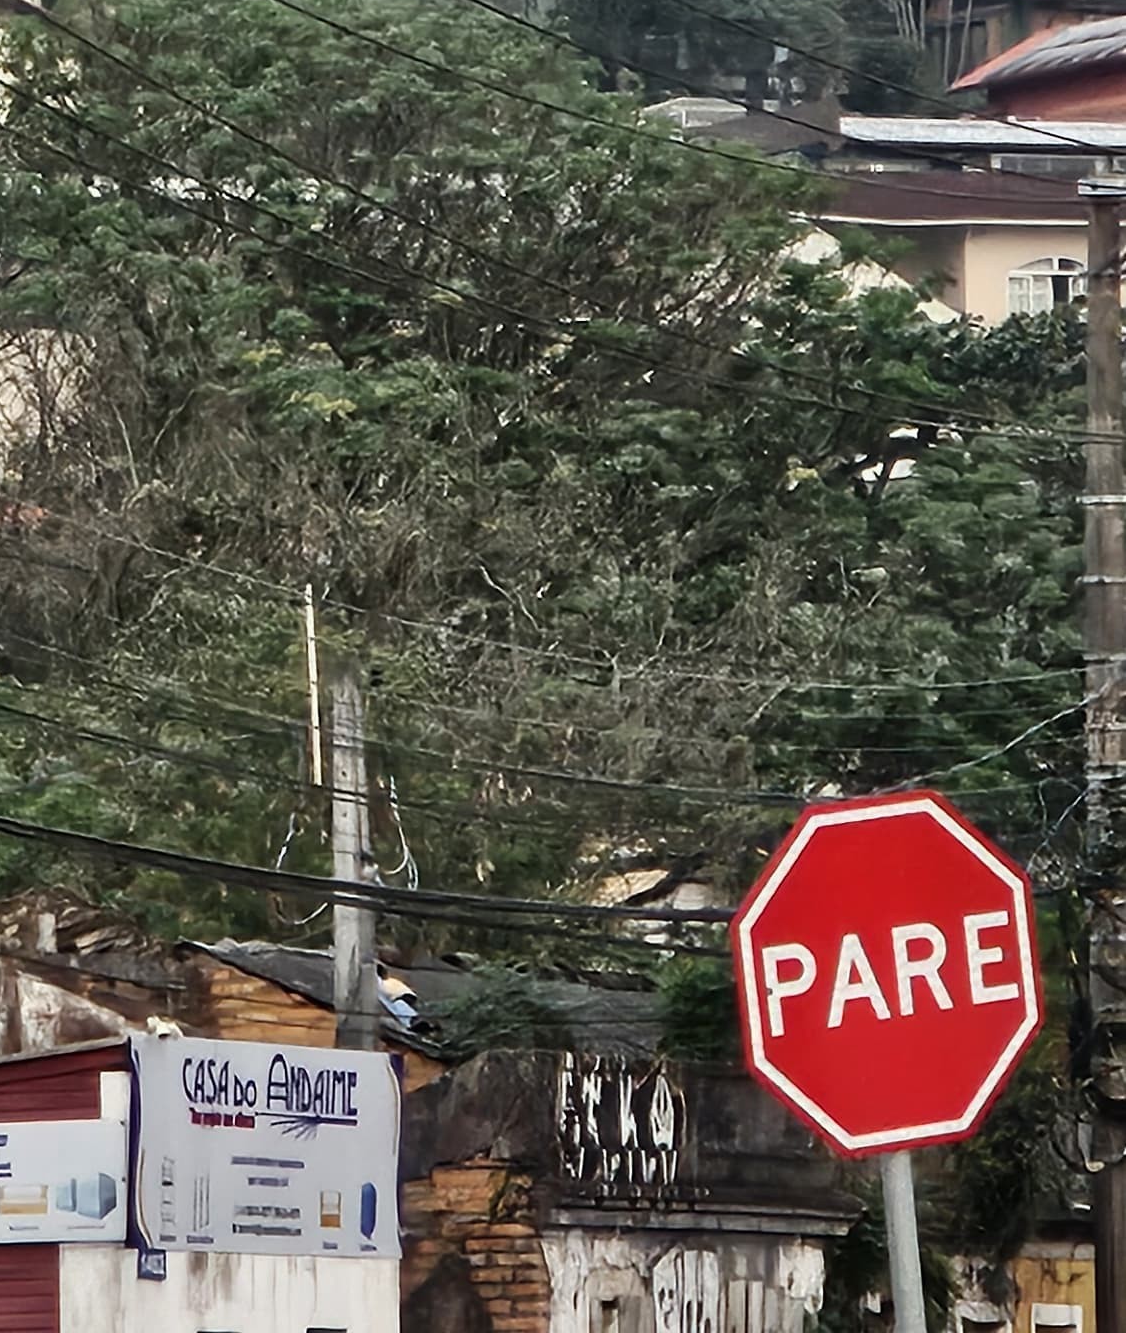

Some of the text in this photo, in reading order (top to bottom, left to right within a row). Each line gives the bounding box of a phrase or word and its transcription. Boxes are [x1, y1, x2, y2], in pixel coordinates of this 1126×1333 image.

[761, 909, 1020, 1038] PARE
[182, 1053, 358, 1116] CASA DO ANDAIME
